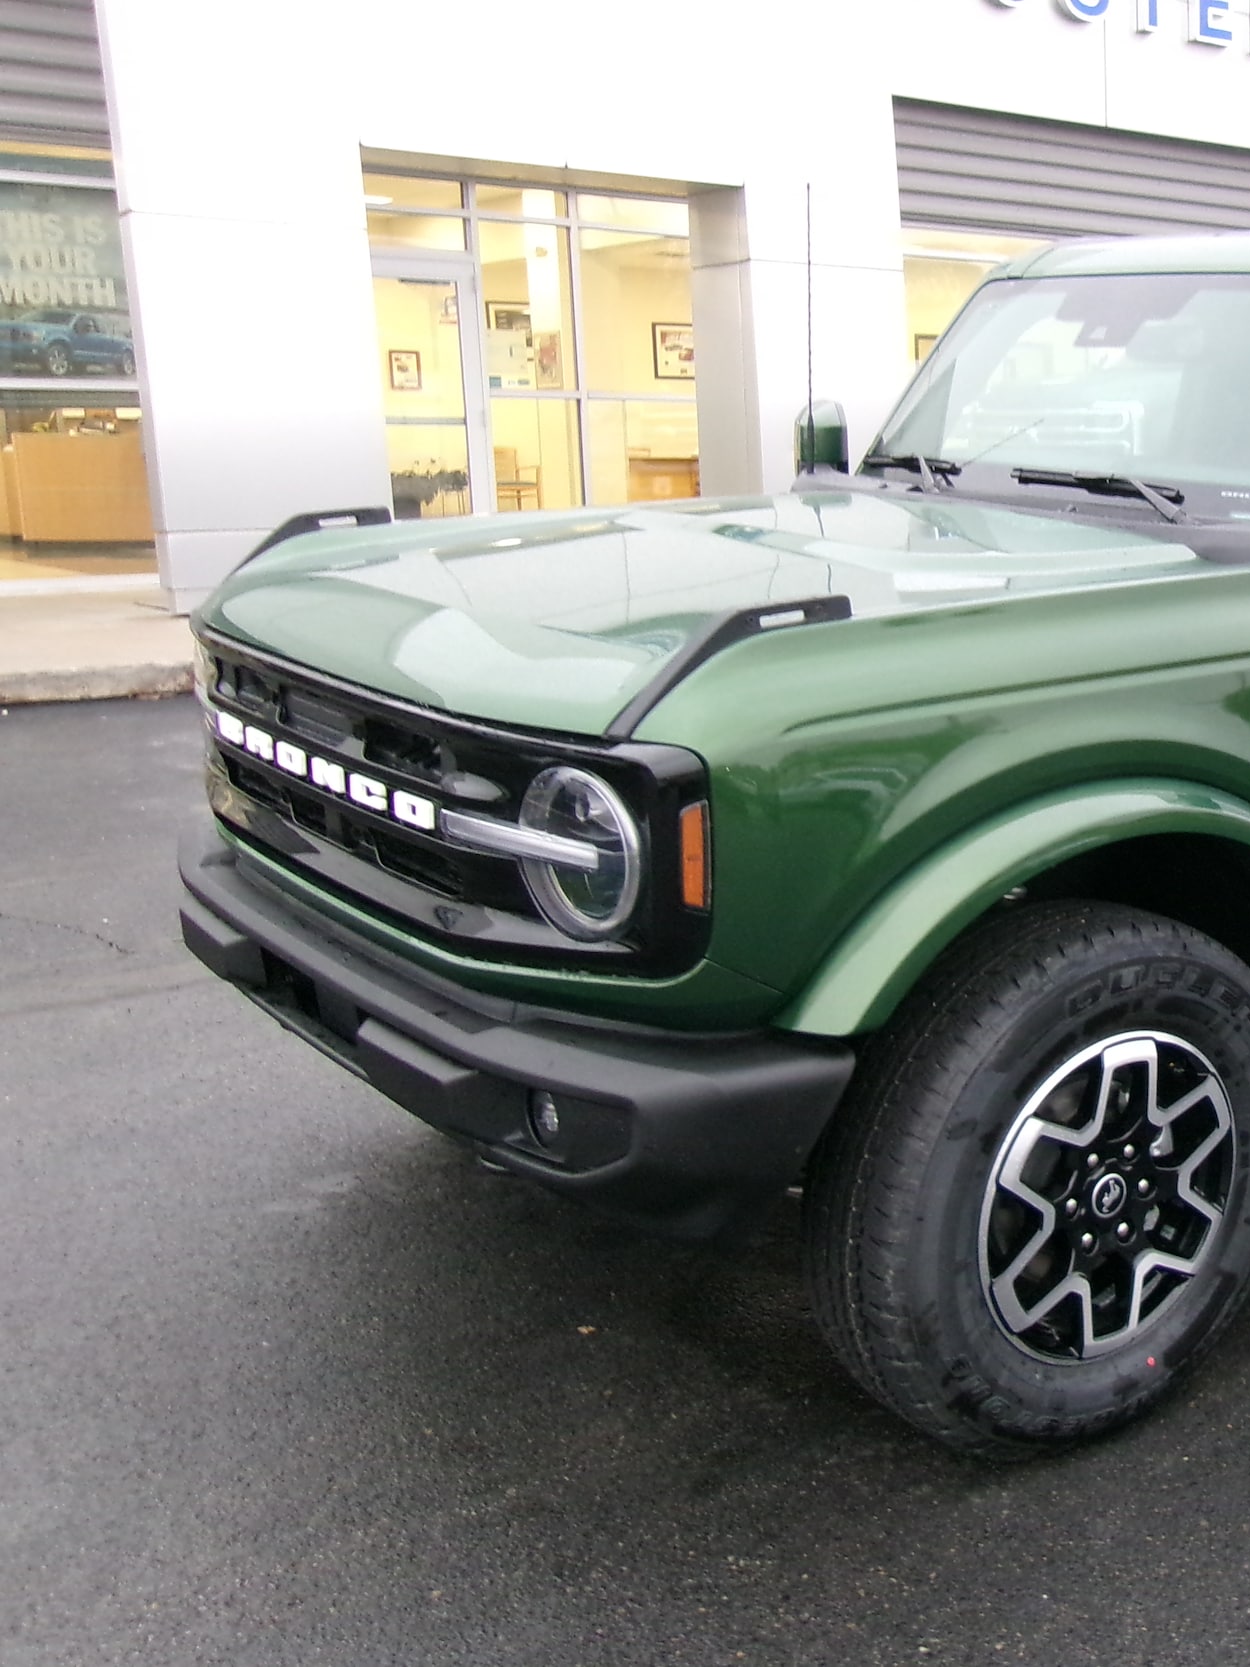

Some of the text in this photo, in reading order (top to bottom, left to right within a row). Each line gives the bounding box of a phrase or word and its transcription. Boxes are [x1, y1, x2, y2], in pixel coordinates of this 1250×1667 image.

[0, 211, 107, 245] HIS IS
[2, 243, 97, 274] YOUR
[217, 710, 435, 830] BRONCO
